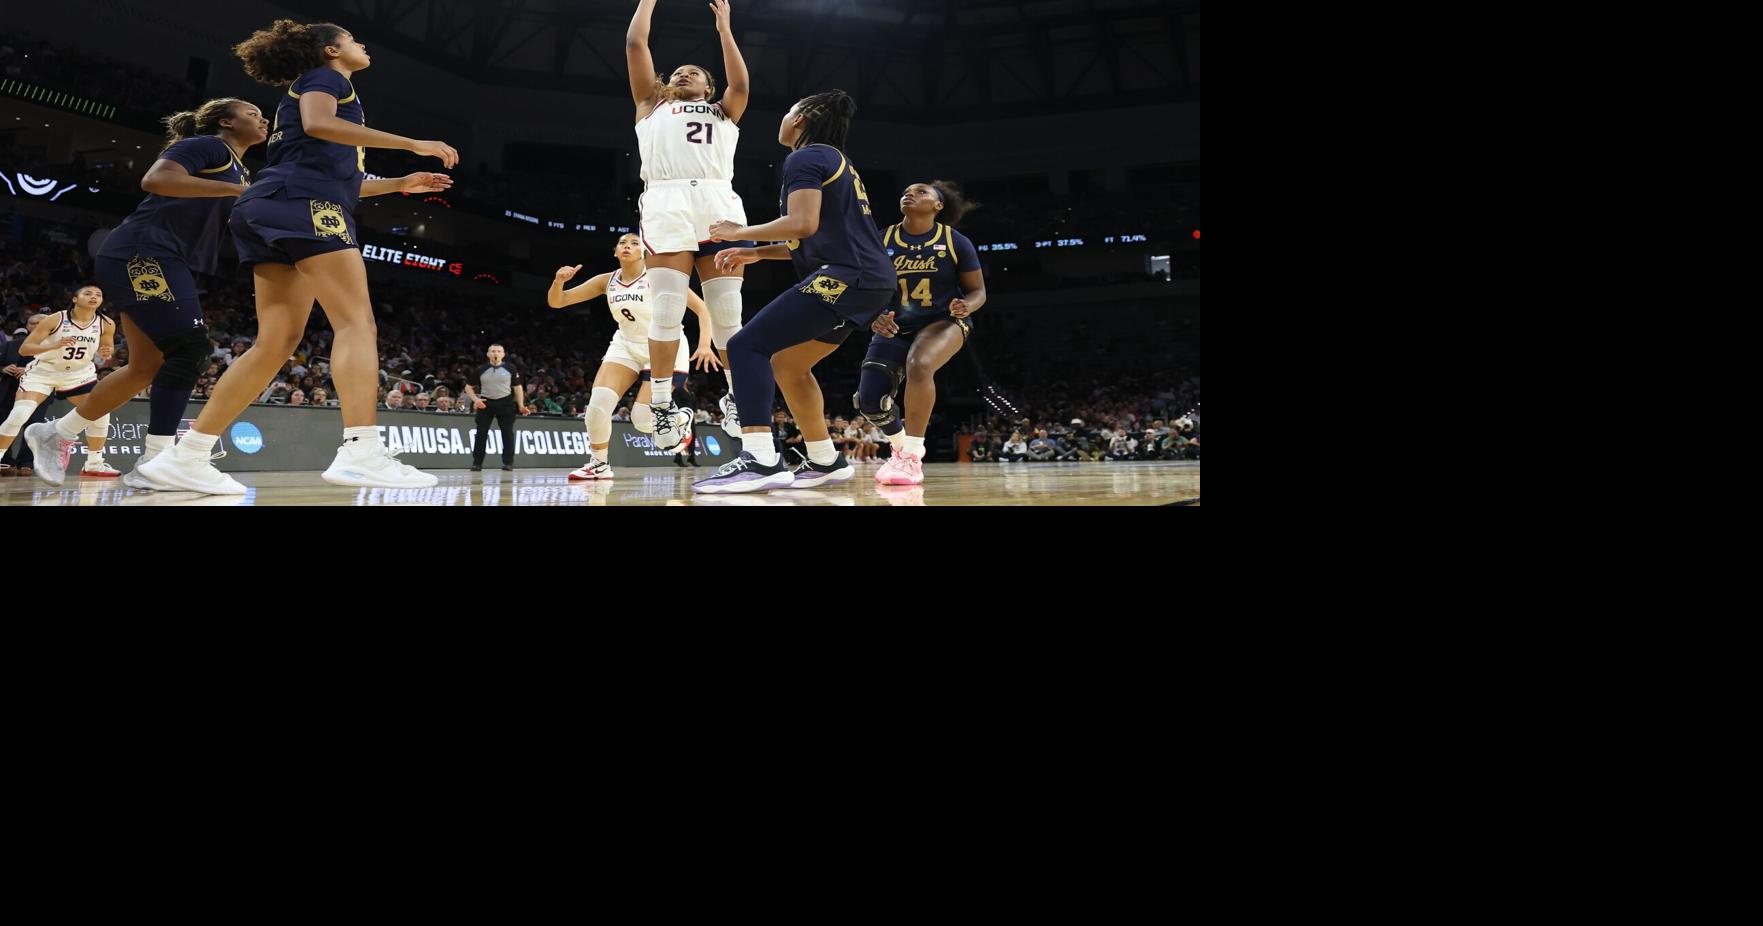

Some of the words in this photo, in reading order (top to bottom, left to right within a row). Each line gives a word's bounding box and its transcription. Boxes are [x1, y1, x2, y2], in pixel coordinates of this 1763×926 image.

[672, 105, 724, 121] UCONN
[686, 122, 712, 144] 21
[362, 244, 403, 264] ELITE
[404, 252, 446, 271] EIGHT
[894, 255, 937, 274] Irish
[610, 294, 643, 304] UCONN
[899, 278, 933, 307] 14
[621, 308, 635, 321] 8
[63, 347, 87, 360] 35
